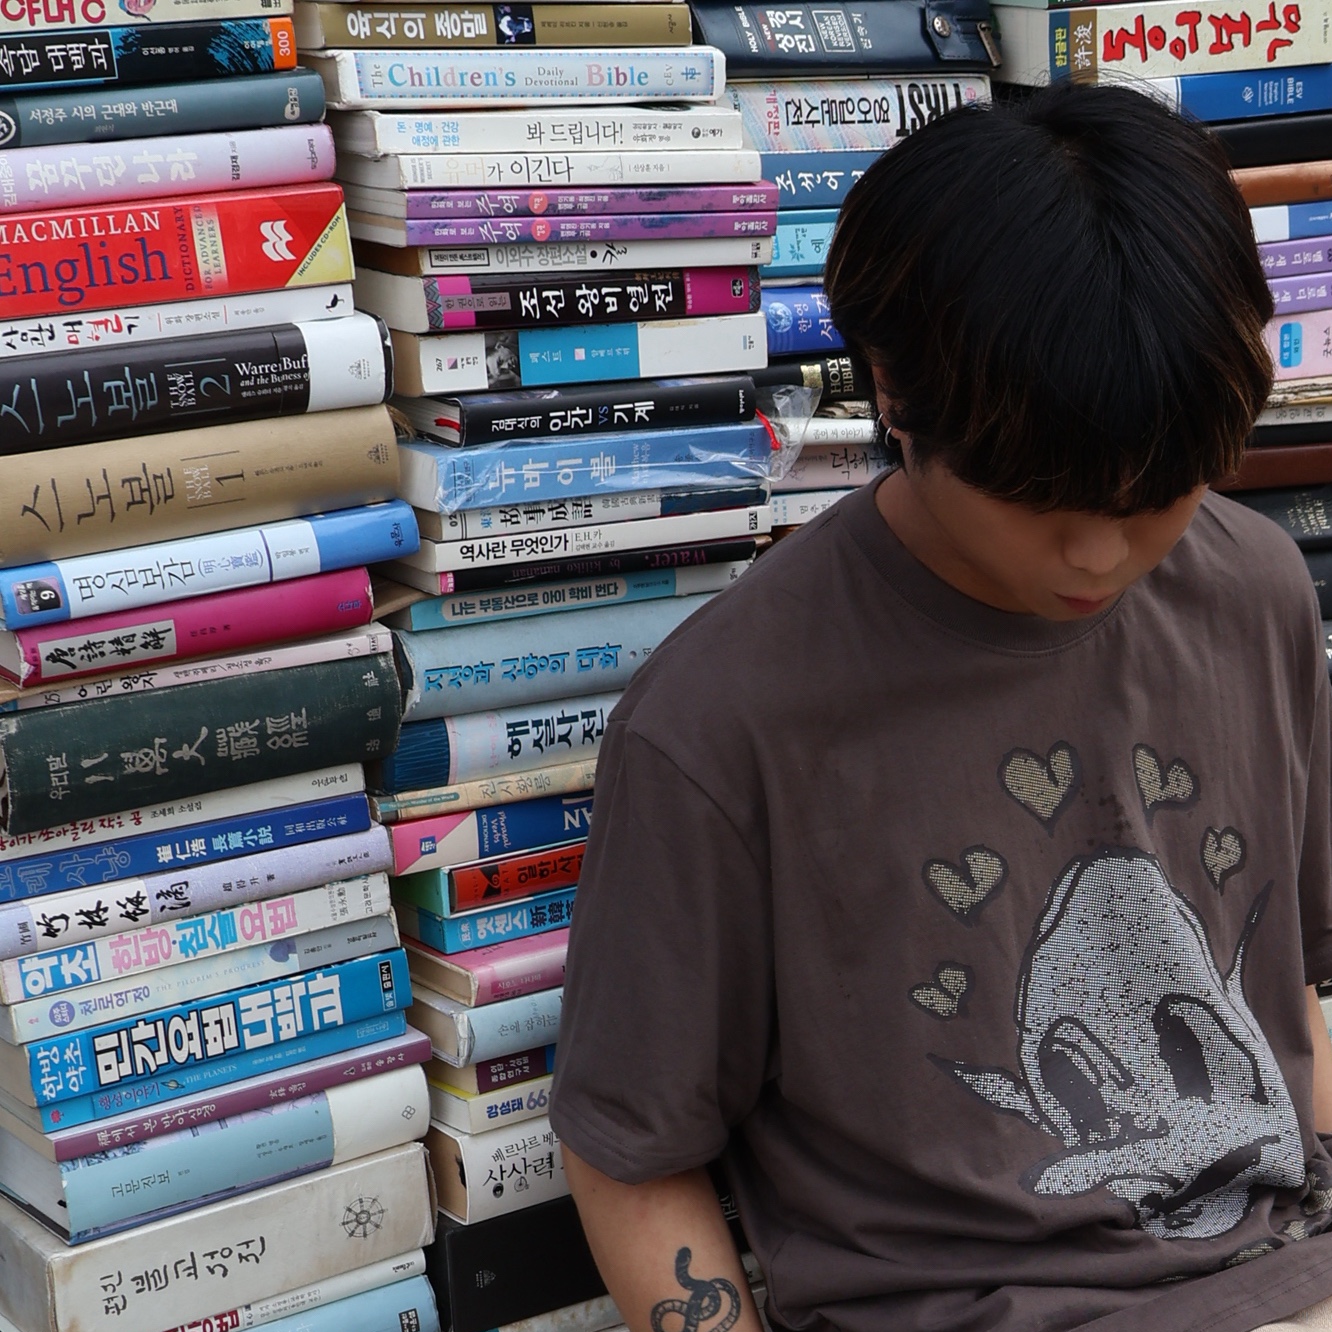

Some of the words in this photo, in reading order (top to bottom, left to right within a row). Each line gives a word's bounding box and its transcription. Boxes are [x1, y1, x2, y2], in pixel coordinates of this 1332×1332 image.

[435, 9, 488, 39] 종말
[278, 30, 291, 57] 300
[371, 63, 384, 88] The
[388, 62, 517, 87] Children's
[524, 75, 579, 87] Devotional
[537, 66, 565, 79] Daily
[586, 63, 650, 88] Bible
[664, 63, 674, 87] CEV
[1286, 77, 1295, 105] BIBLE
[1295, 81, 1303, 100] ESV
[29, 105, 68, 125] 서정주
[101, 99, 138, 119] 근대와
[784, 97, 891, 128] 영어입문사전
[411, 135, 439, 147] 애정에
[442, 134, 460, 147] 관한
[526, 124, 546, 146] 봐
[550, 122, 624, 146] 드립니다!
[27, 153, 127, 194] 꿈꾸던
[133, 147, 199, 183] 나라
[192, 205, 211, 262] ADVANCED
[208, 219, 224, 275] LEARNERS
[178, 206, 196, 292] DICTIONARY
[296, 241, 325, 278] INCLUDES
[496, 246, 535, 267] 이외수
[537, 244, 588, 266] 장편소설
[204, 264, 215, 290] FOR
[186, 370, 198, 408] BALL
[199, 373, 232, 399] 2
[827, 358, 842, 395] HOLY
[1, 365, 159, 435] 스노볼
[549, 404, 594, 431] 인간
[613, 400, 656, 423] 기계
[202, 464, 213, 499] BALL
[215, 468, 246, 488] 1
[21, 462, 175, 534] 스노볼
[459, 535, 509, 561] 역사란
[510, 531, 569, 558] 무엇인가
[72, 558, 197, 602] 명심보감
[41, 590, 55, 601] 9
[424, 661, 495, 692] 지성과
[502, 652, 571, 684] 신앙의
[576, 642, 624, 671] 대화
[506, 706, 605, 760] 해설사전
[50, 752, 69, 799] 우리말
[482, 814, 491, 853] DICTIONARY
[157, 838, 207, 864] 崔仁浩
[79, 985, 152, 1015] 천로역정
[96, 998, 240, 1090] 민간요법
[238, 971, 344, 1050] 대백과
[41, 1043, 58, 1099] 한방
[68, 1037, 84, 1093] 약초
[202, 1063, 238, 1080] PLANETS
[491, 1133, 541, 1164] 베르나르
[112, 1169, 172, 1199] 고문진보
